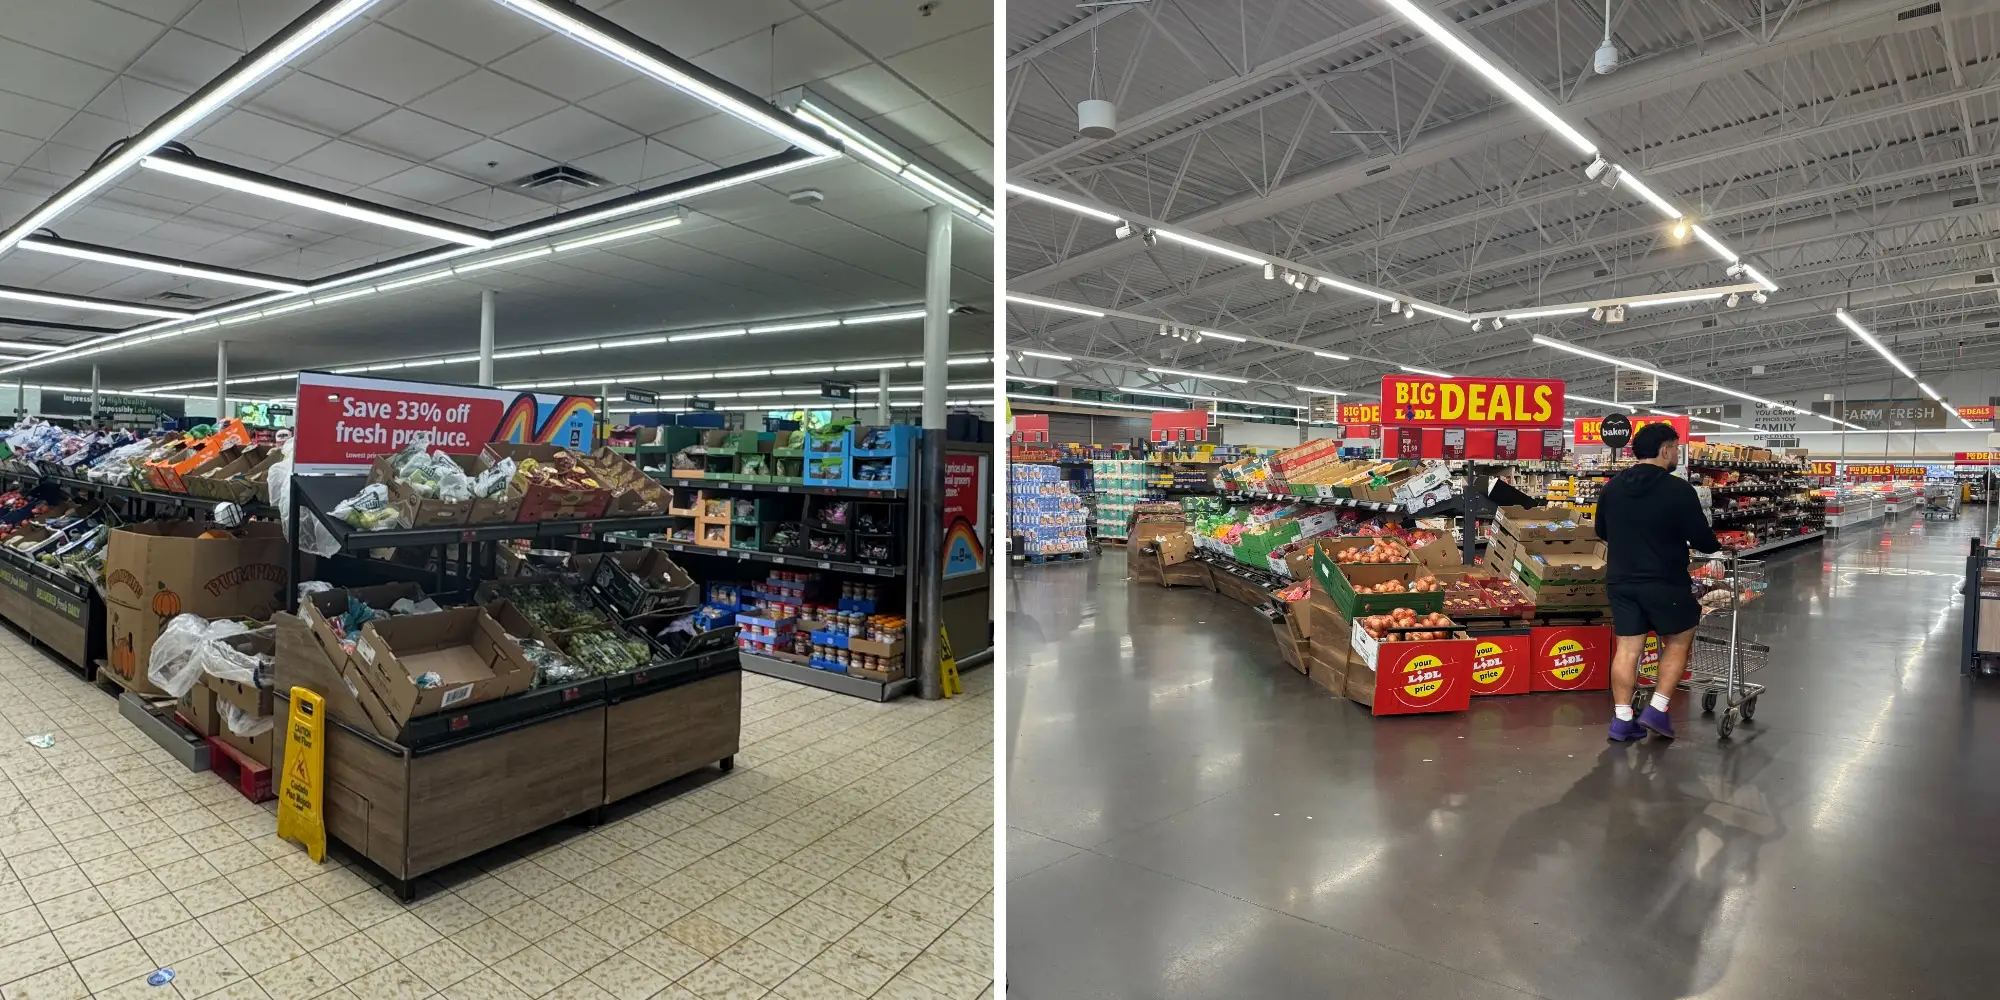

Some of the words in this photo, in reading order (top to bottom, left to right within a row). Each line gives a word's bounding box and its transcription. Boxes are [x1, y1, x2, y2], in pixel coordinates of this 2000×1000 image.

[1395, 382, 1436, 405] BIG
[1439, 383, 1553, 422] DEALS
[343, 396, 391, 419] Save
[396, 401, 442, 422] 33%
[446, 404, 471, 424] off
[1343, 406, 1360, 416] BIG
[1844, 409, 1883, 420] FARM
[1889, 407, 1935, 419] FRESH
[336, 420, 387, 445] fresh
[1602, 427, 1630, 437] bakery
[1755, 423, 1797, 432] FAMILY
[1860, 466, 1891, 475] DEALS
[1900, 467, 1925, 475] DEALS
[1558, 644, 1574, 653] your
[1645, 641, 1657, 649] our
[1476, 646, 1493, 656] your
[1413, 659, 1433, 669] your
[1643, 664, 1659, 673] pric
[1479, 671, 1498, 681] price
[1560, 667, 1579, 677] price
[1414, 683, 1435, 694] price
[294, 723, 311, 738] CAUTION
